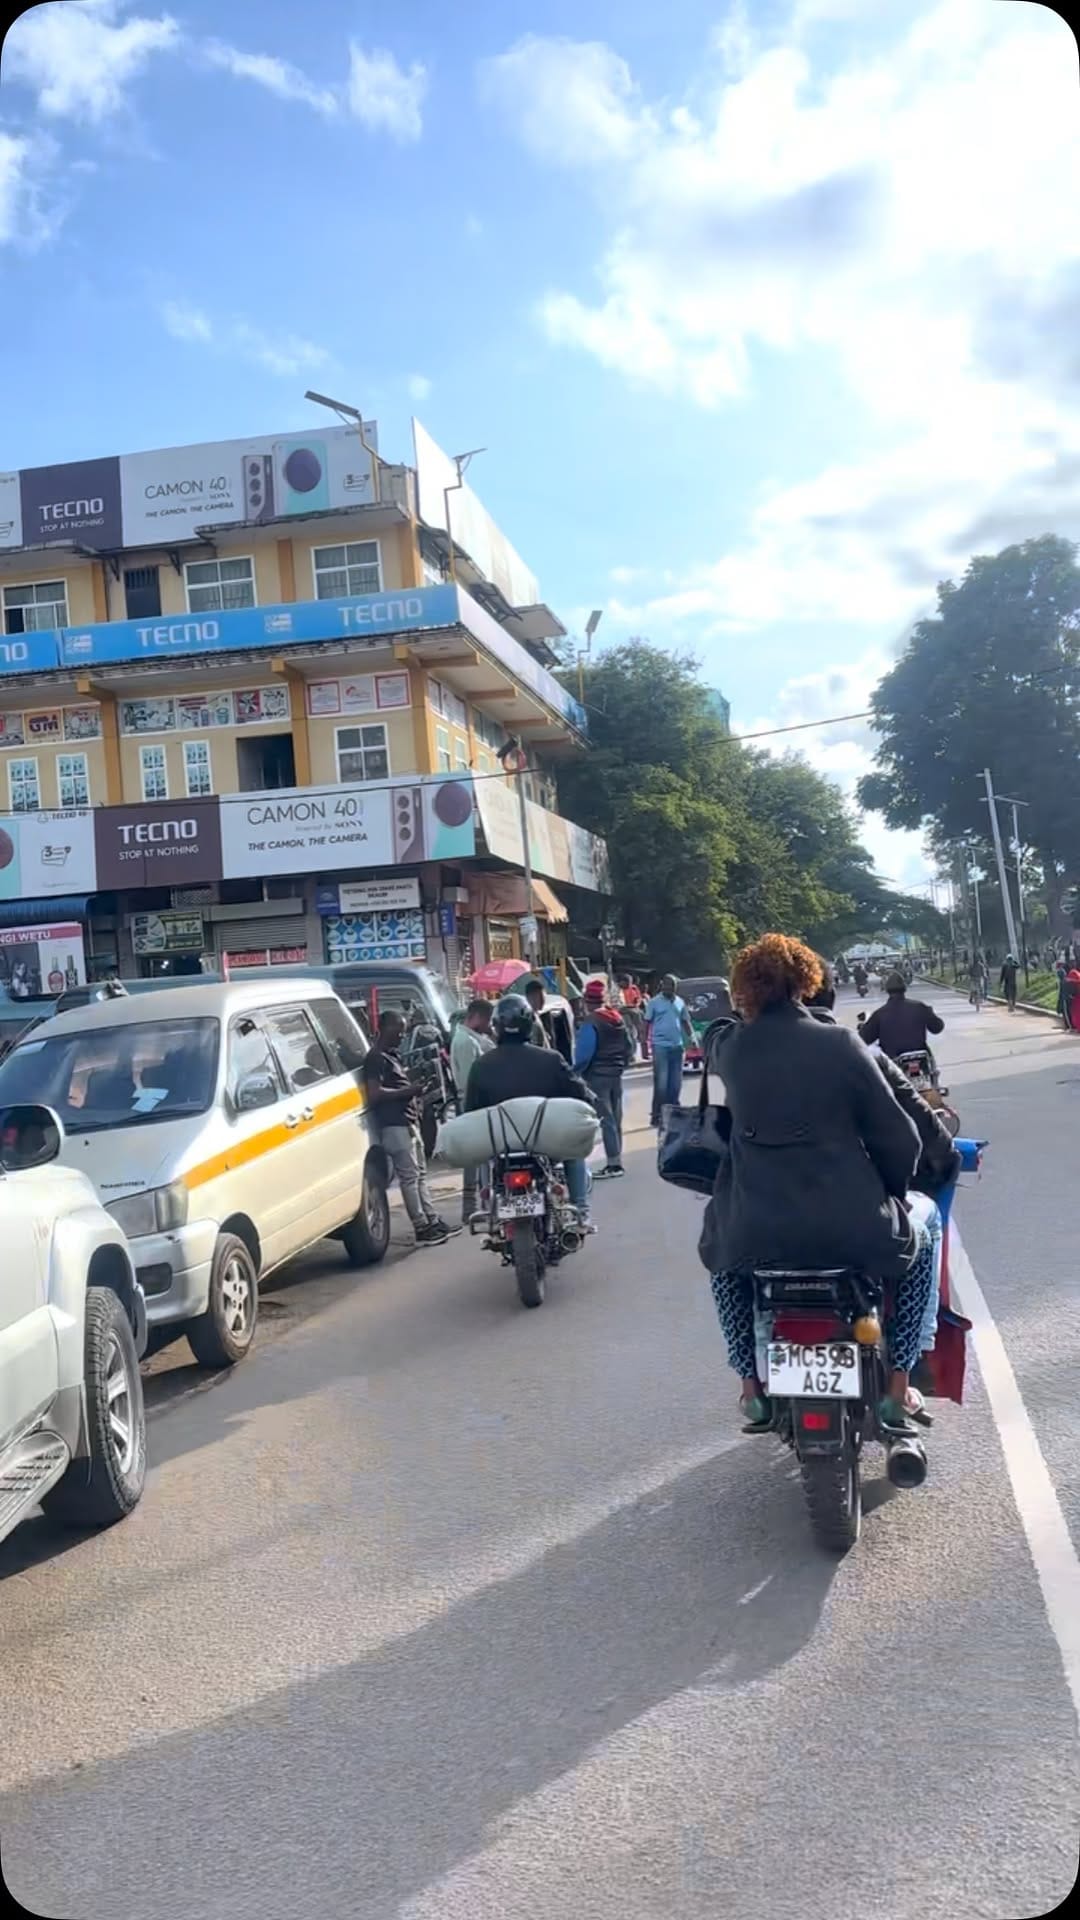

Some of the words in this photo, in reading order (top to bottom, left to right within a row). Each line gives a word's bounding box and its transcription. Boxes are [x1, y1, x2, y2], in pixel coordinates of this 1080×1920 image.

[145, 480, 203, 499] CAMON
[209, 476, 226, 491] 40
[39, 498, 104, 521] TECNO
[204, 502, 234, 511] CAMERA
[40, 524, 58, 534] STOP
[60, 521, 69, 530] AT
[71, 518, 104, 529] NOTHING
[338, 598, 422, 626] TECNO
[136, 621, 219, 647] TECNO
[247, 801, 325, 825] CAMON
[334, 798, 358, 817] 40
[117, 819, 197, 844] TECNO
[248, 842, 265, 851] THE
[309, 836, 327, 846] THE
[329, 833, 368, 844] CAMERA
[119, 849, 142, 861] STOP
[144, 848, 155, 857] AT
[156, 844, 199, 857] NOTHING
[18, 930, 51, 942] WETU
[802, 1371, 843, 1393] AGZ
